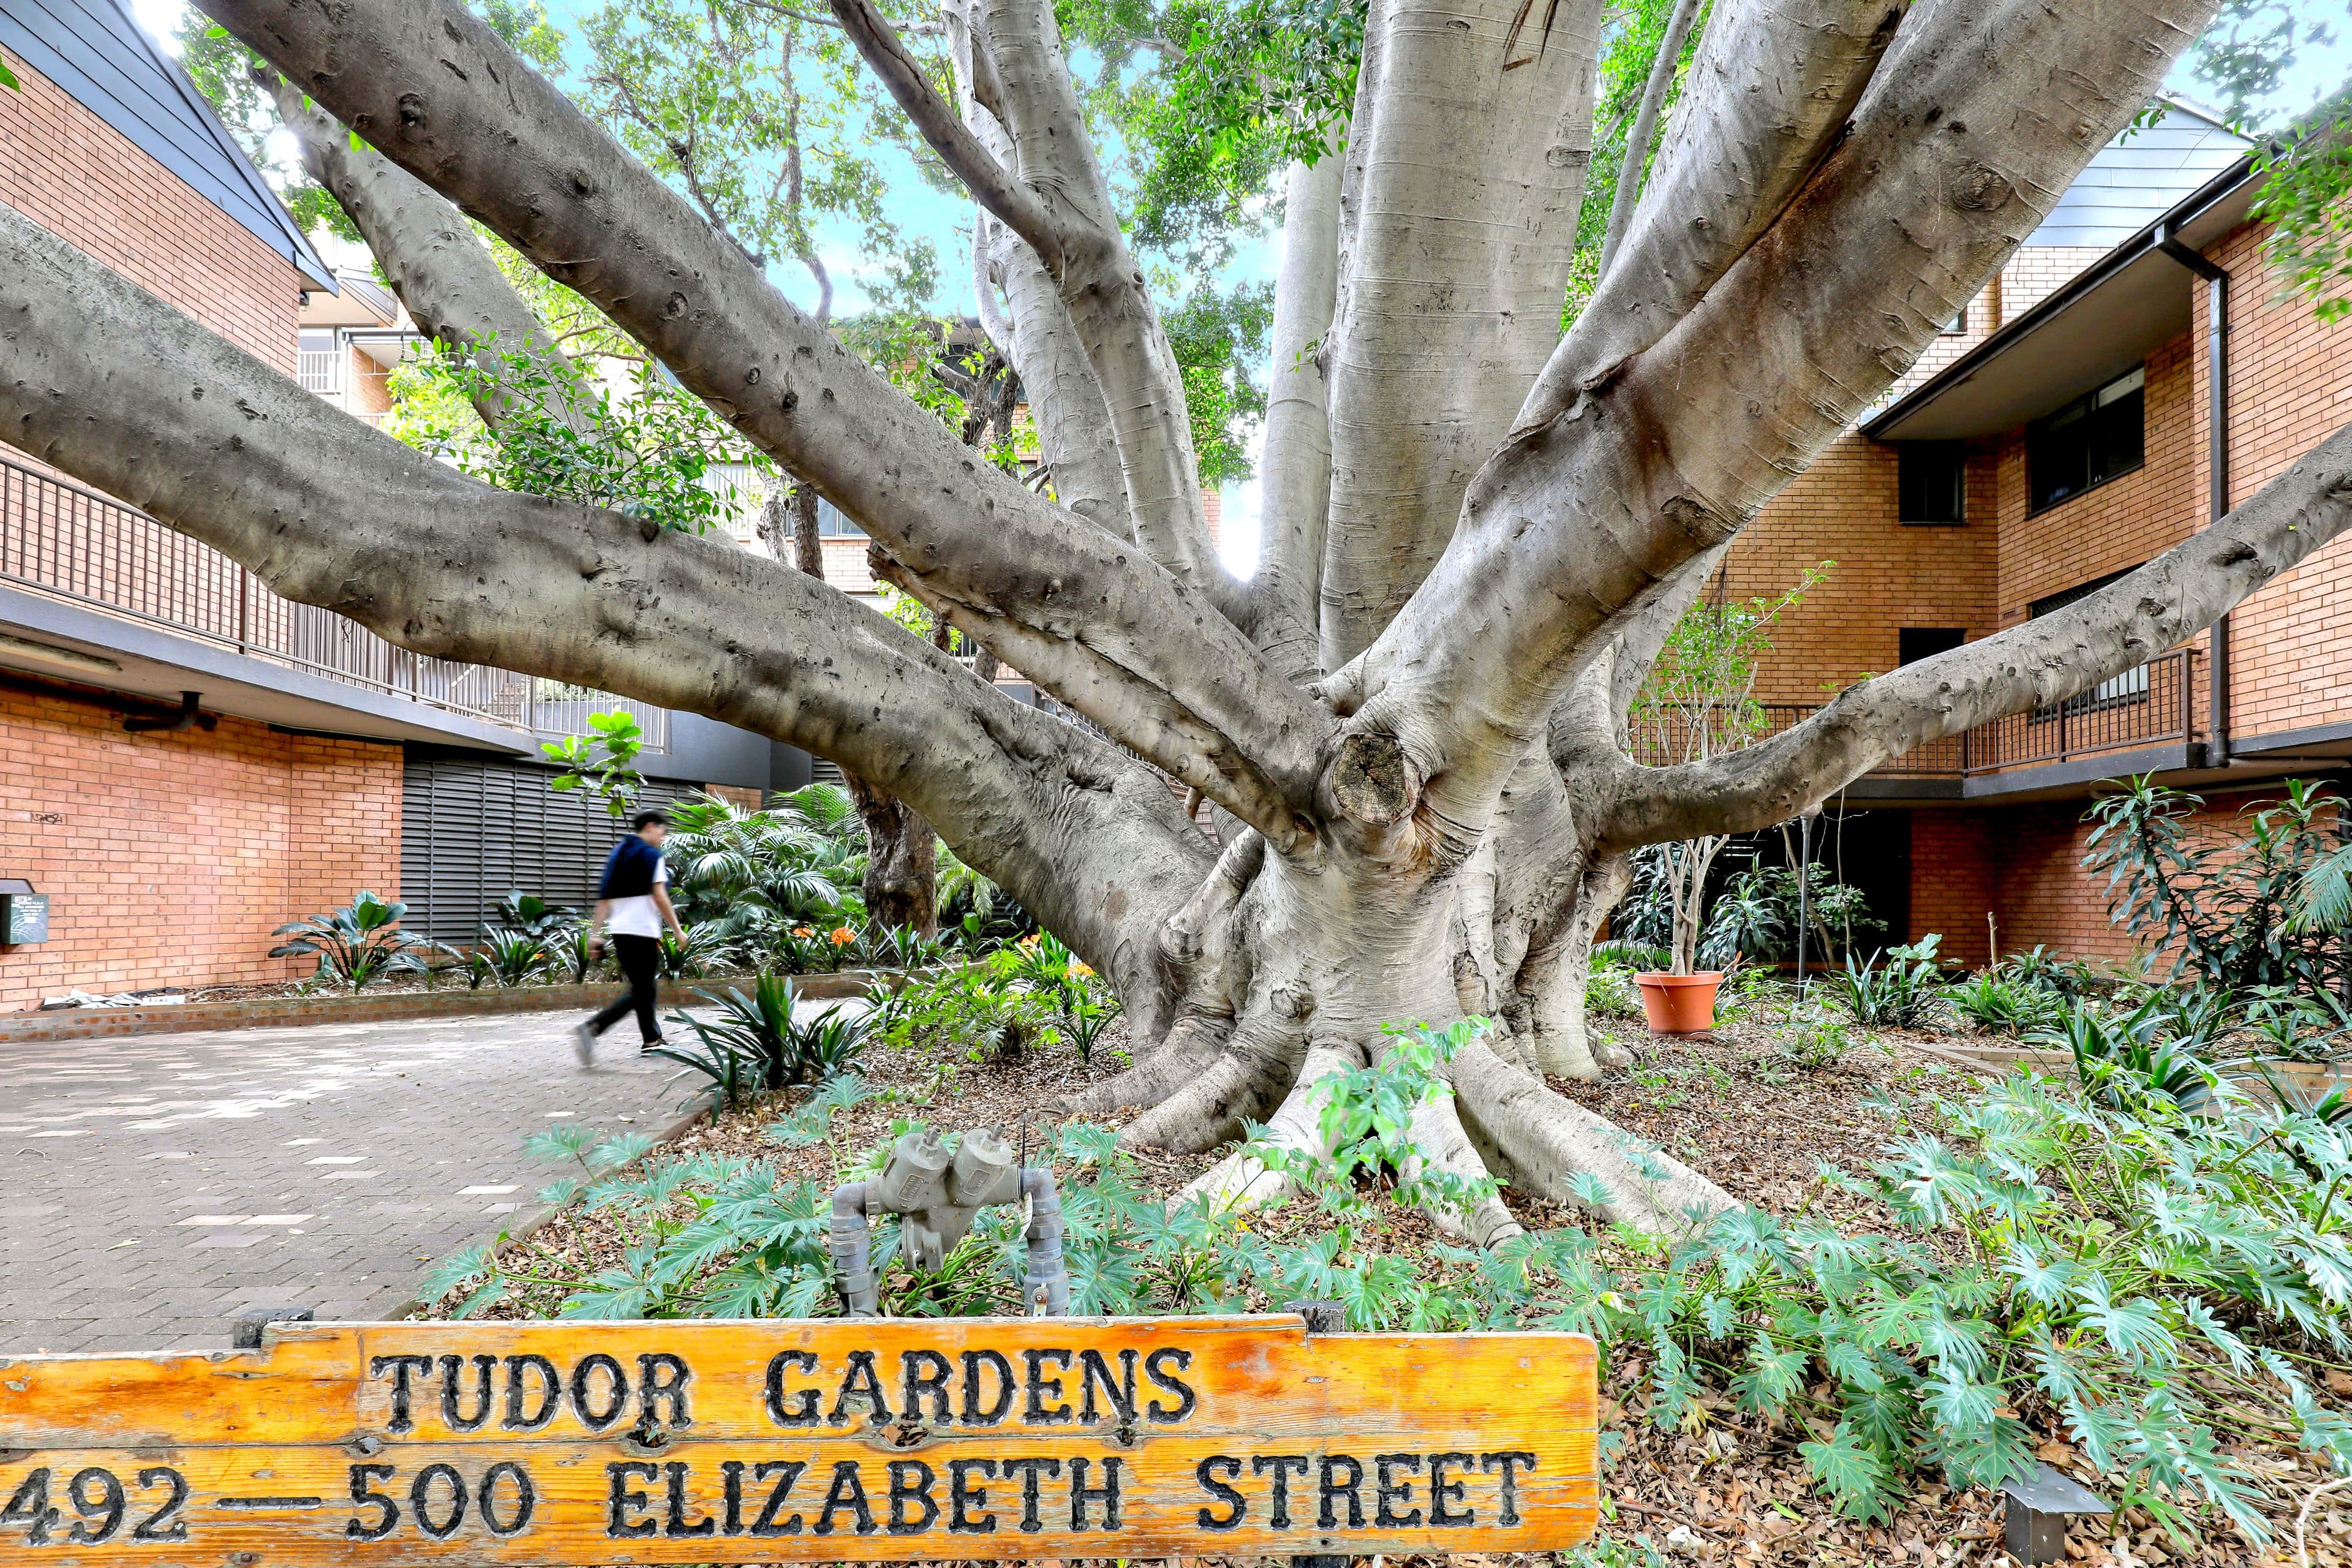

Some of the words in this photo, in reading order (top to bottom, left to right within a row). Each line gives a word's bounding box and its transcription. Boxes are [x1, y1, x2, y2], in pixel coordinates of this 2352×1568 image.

[370, 1352, 692, 1434] TUDOR
[764, 1346, 1197, 1428] GARDENS
[605, 1456, 1125, 1540] ELIZABETH
[1194, 1450, 1537, 1532] STREET
